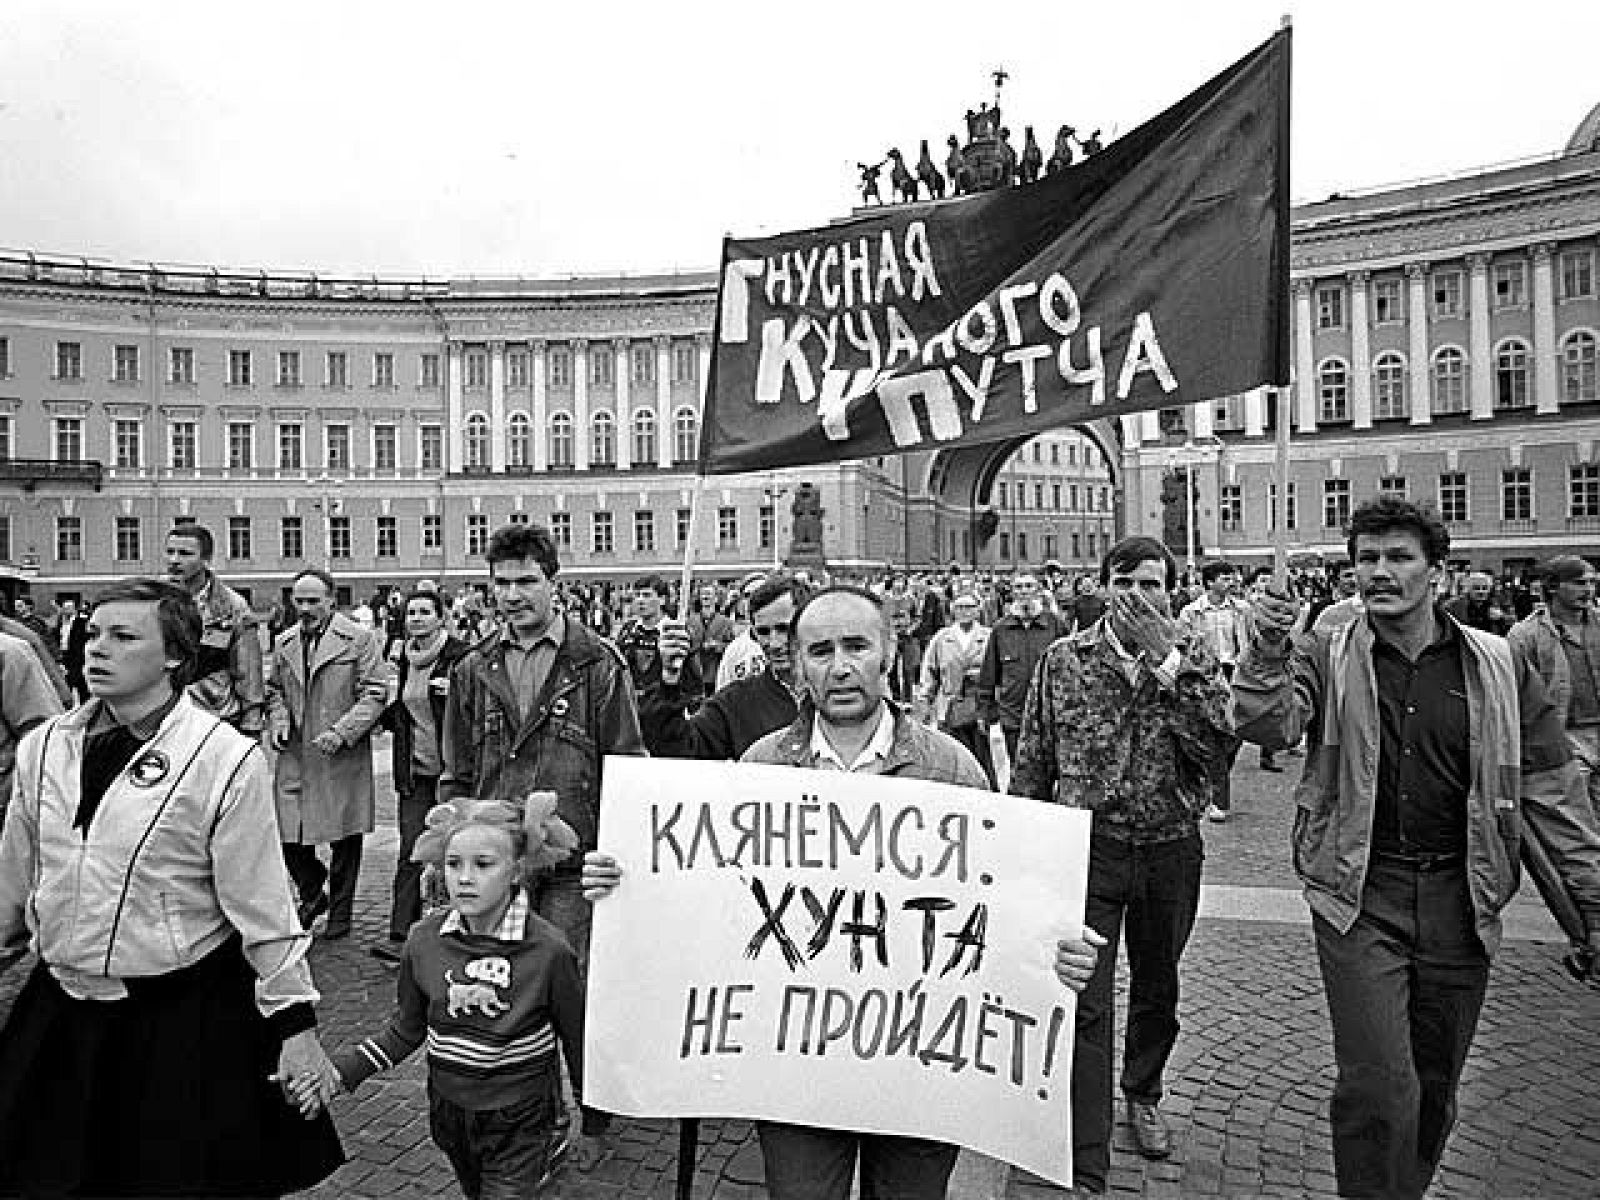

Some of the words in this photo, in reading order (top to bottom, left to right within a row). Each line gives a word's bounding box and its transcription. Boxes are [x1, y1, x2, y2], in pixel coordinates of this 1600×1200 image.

[720, 221, 941, 343] ГНУСНАЯ
[755, 306, 918, 403] КУЧА
[877, 312, 1178, 446] ПУТЧА
[650, 794, 996, 885] КЛЯНЁМСЯ:
[742, 875, 988, 977] ХУНТА
[680, 984, 754, 1059] НЕ
[776, 979, 1066, 1100] ПРОЙДЁТ!
